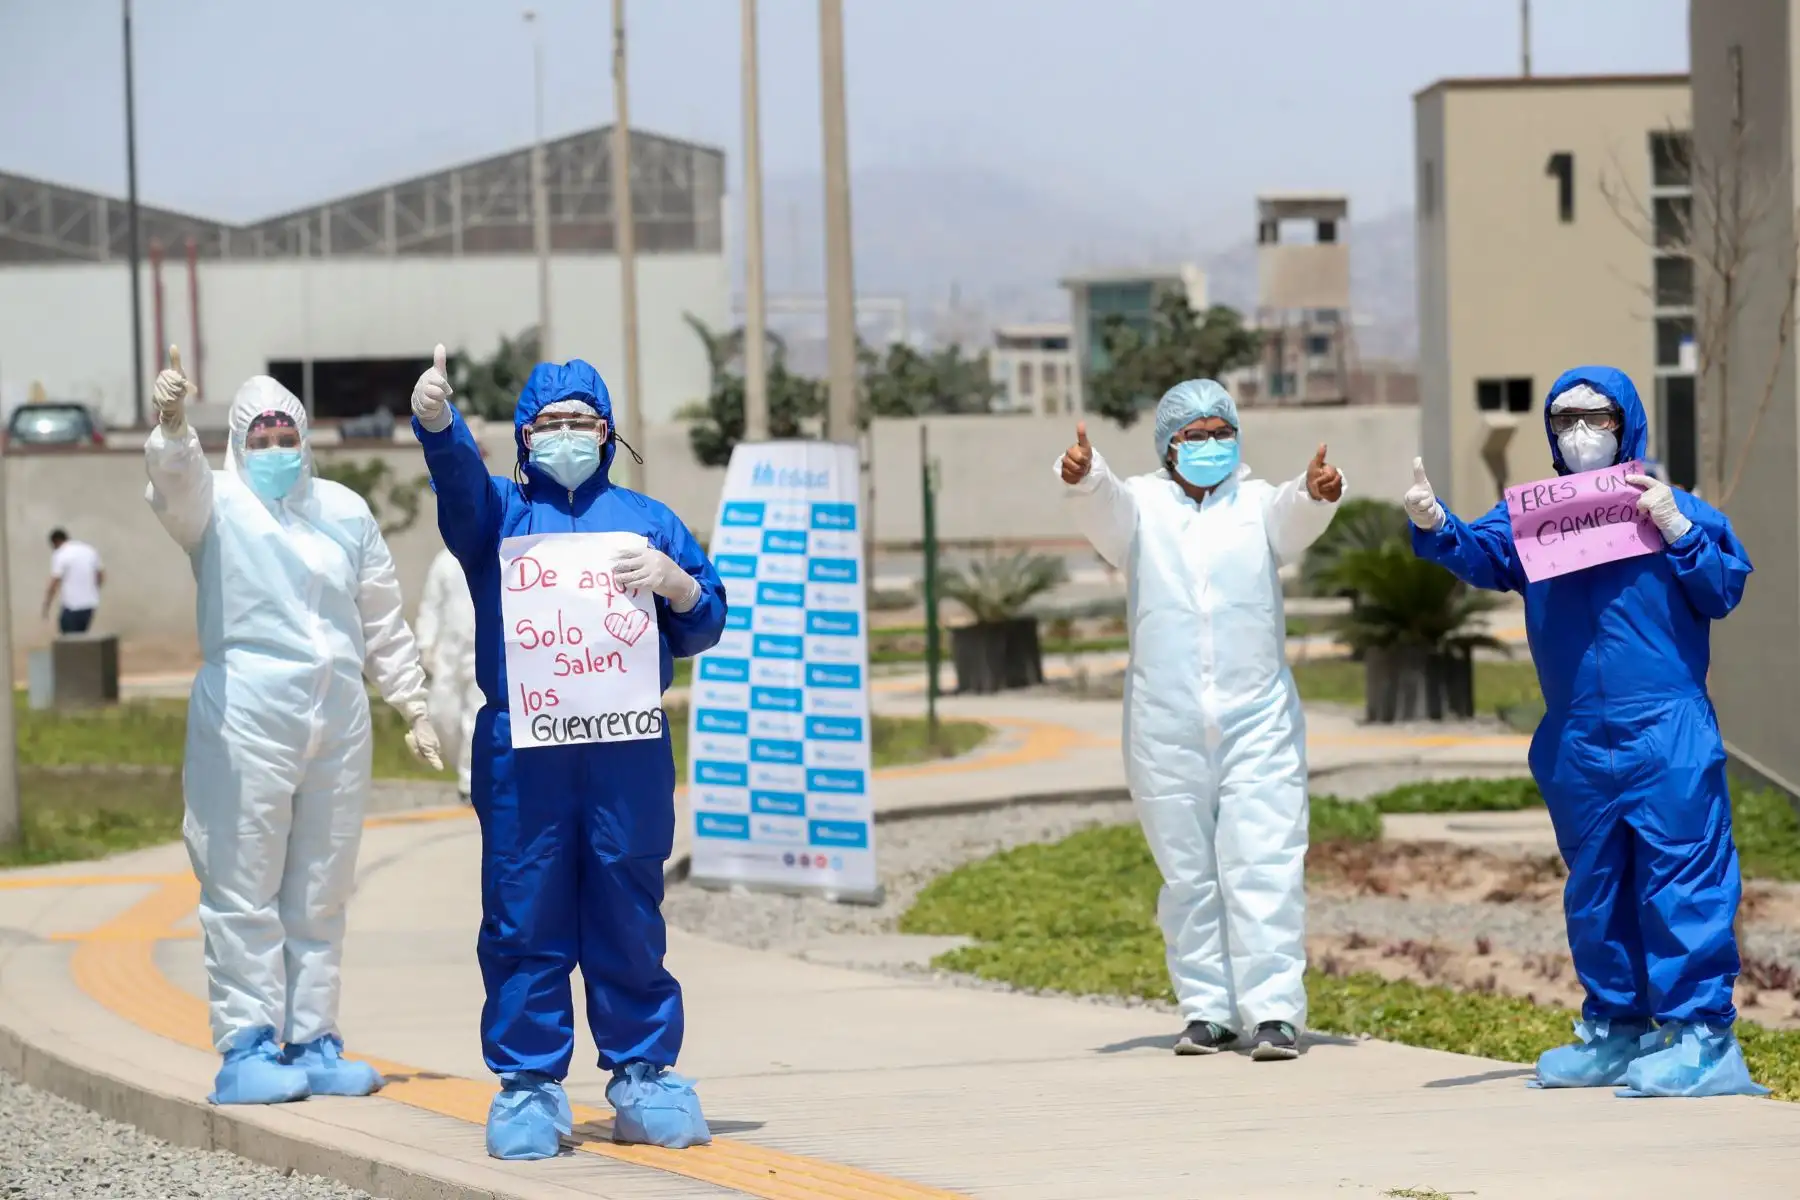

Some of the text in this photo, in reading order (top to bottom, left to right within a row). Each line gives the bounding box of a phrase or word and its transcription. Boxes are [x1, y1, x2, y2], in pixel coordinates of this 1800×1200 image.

[1545, 152, 1573, 223] 1
[1521, 481, 1577, 514] ERES
[1537, 505, 1650, 546] CAMPEO
[506, 556, 557, 592] De
[516, 609, 583, 650] Solo
[520, 682, 559, 716] los
[531, 707, 663, 743] Guerreros
